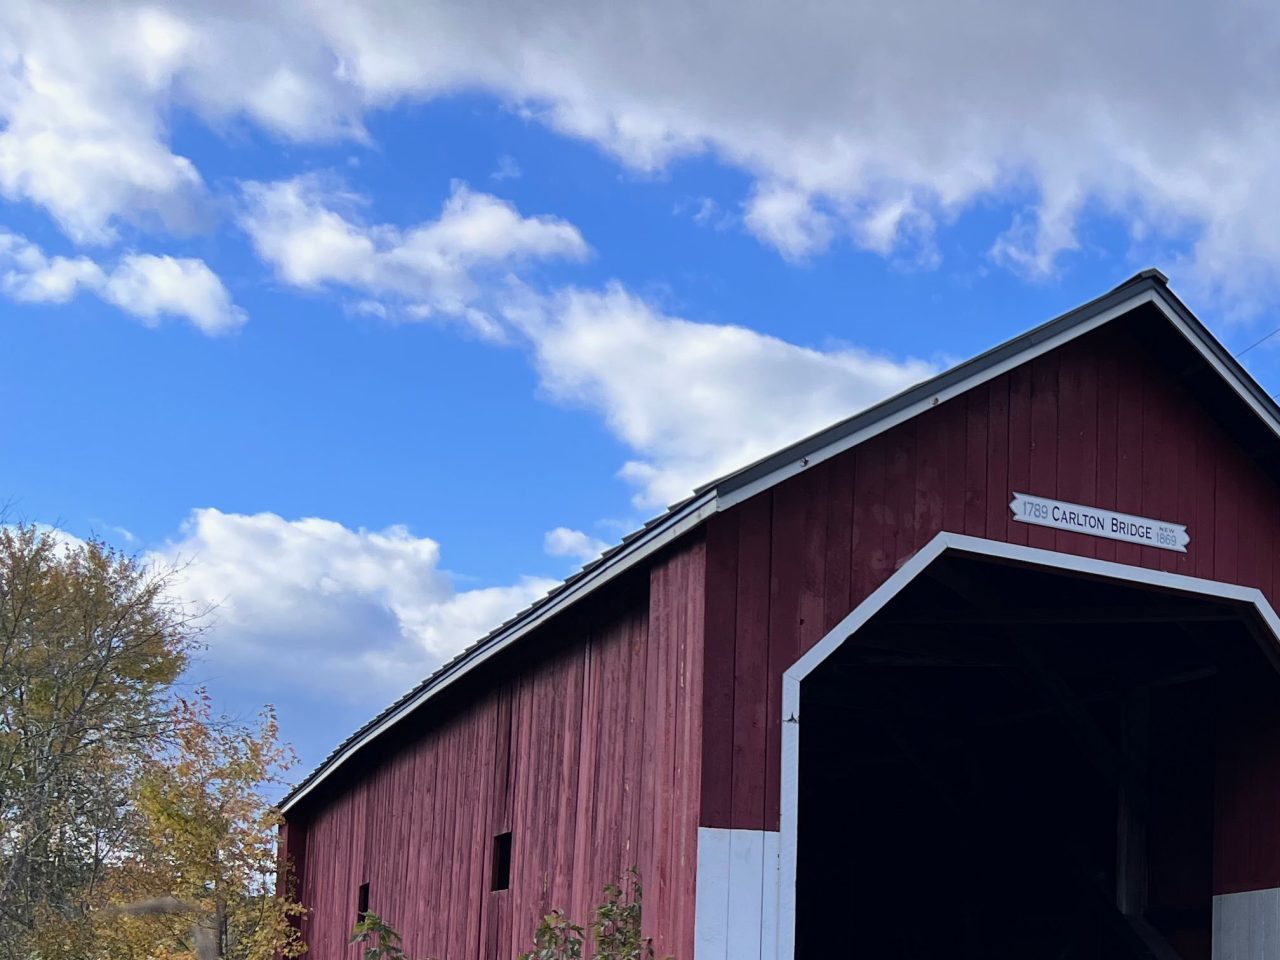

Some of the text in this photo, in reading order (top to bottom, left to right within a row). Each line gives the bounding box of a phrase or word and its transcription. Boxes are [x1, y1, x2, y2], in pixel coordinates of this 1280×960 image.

[1023, 501, 1152, 539] 1789 CARLTON BRIDGE
[1156, 532, 1177, 546] 1869
